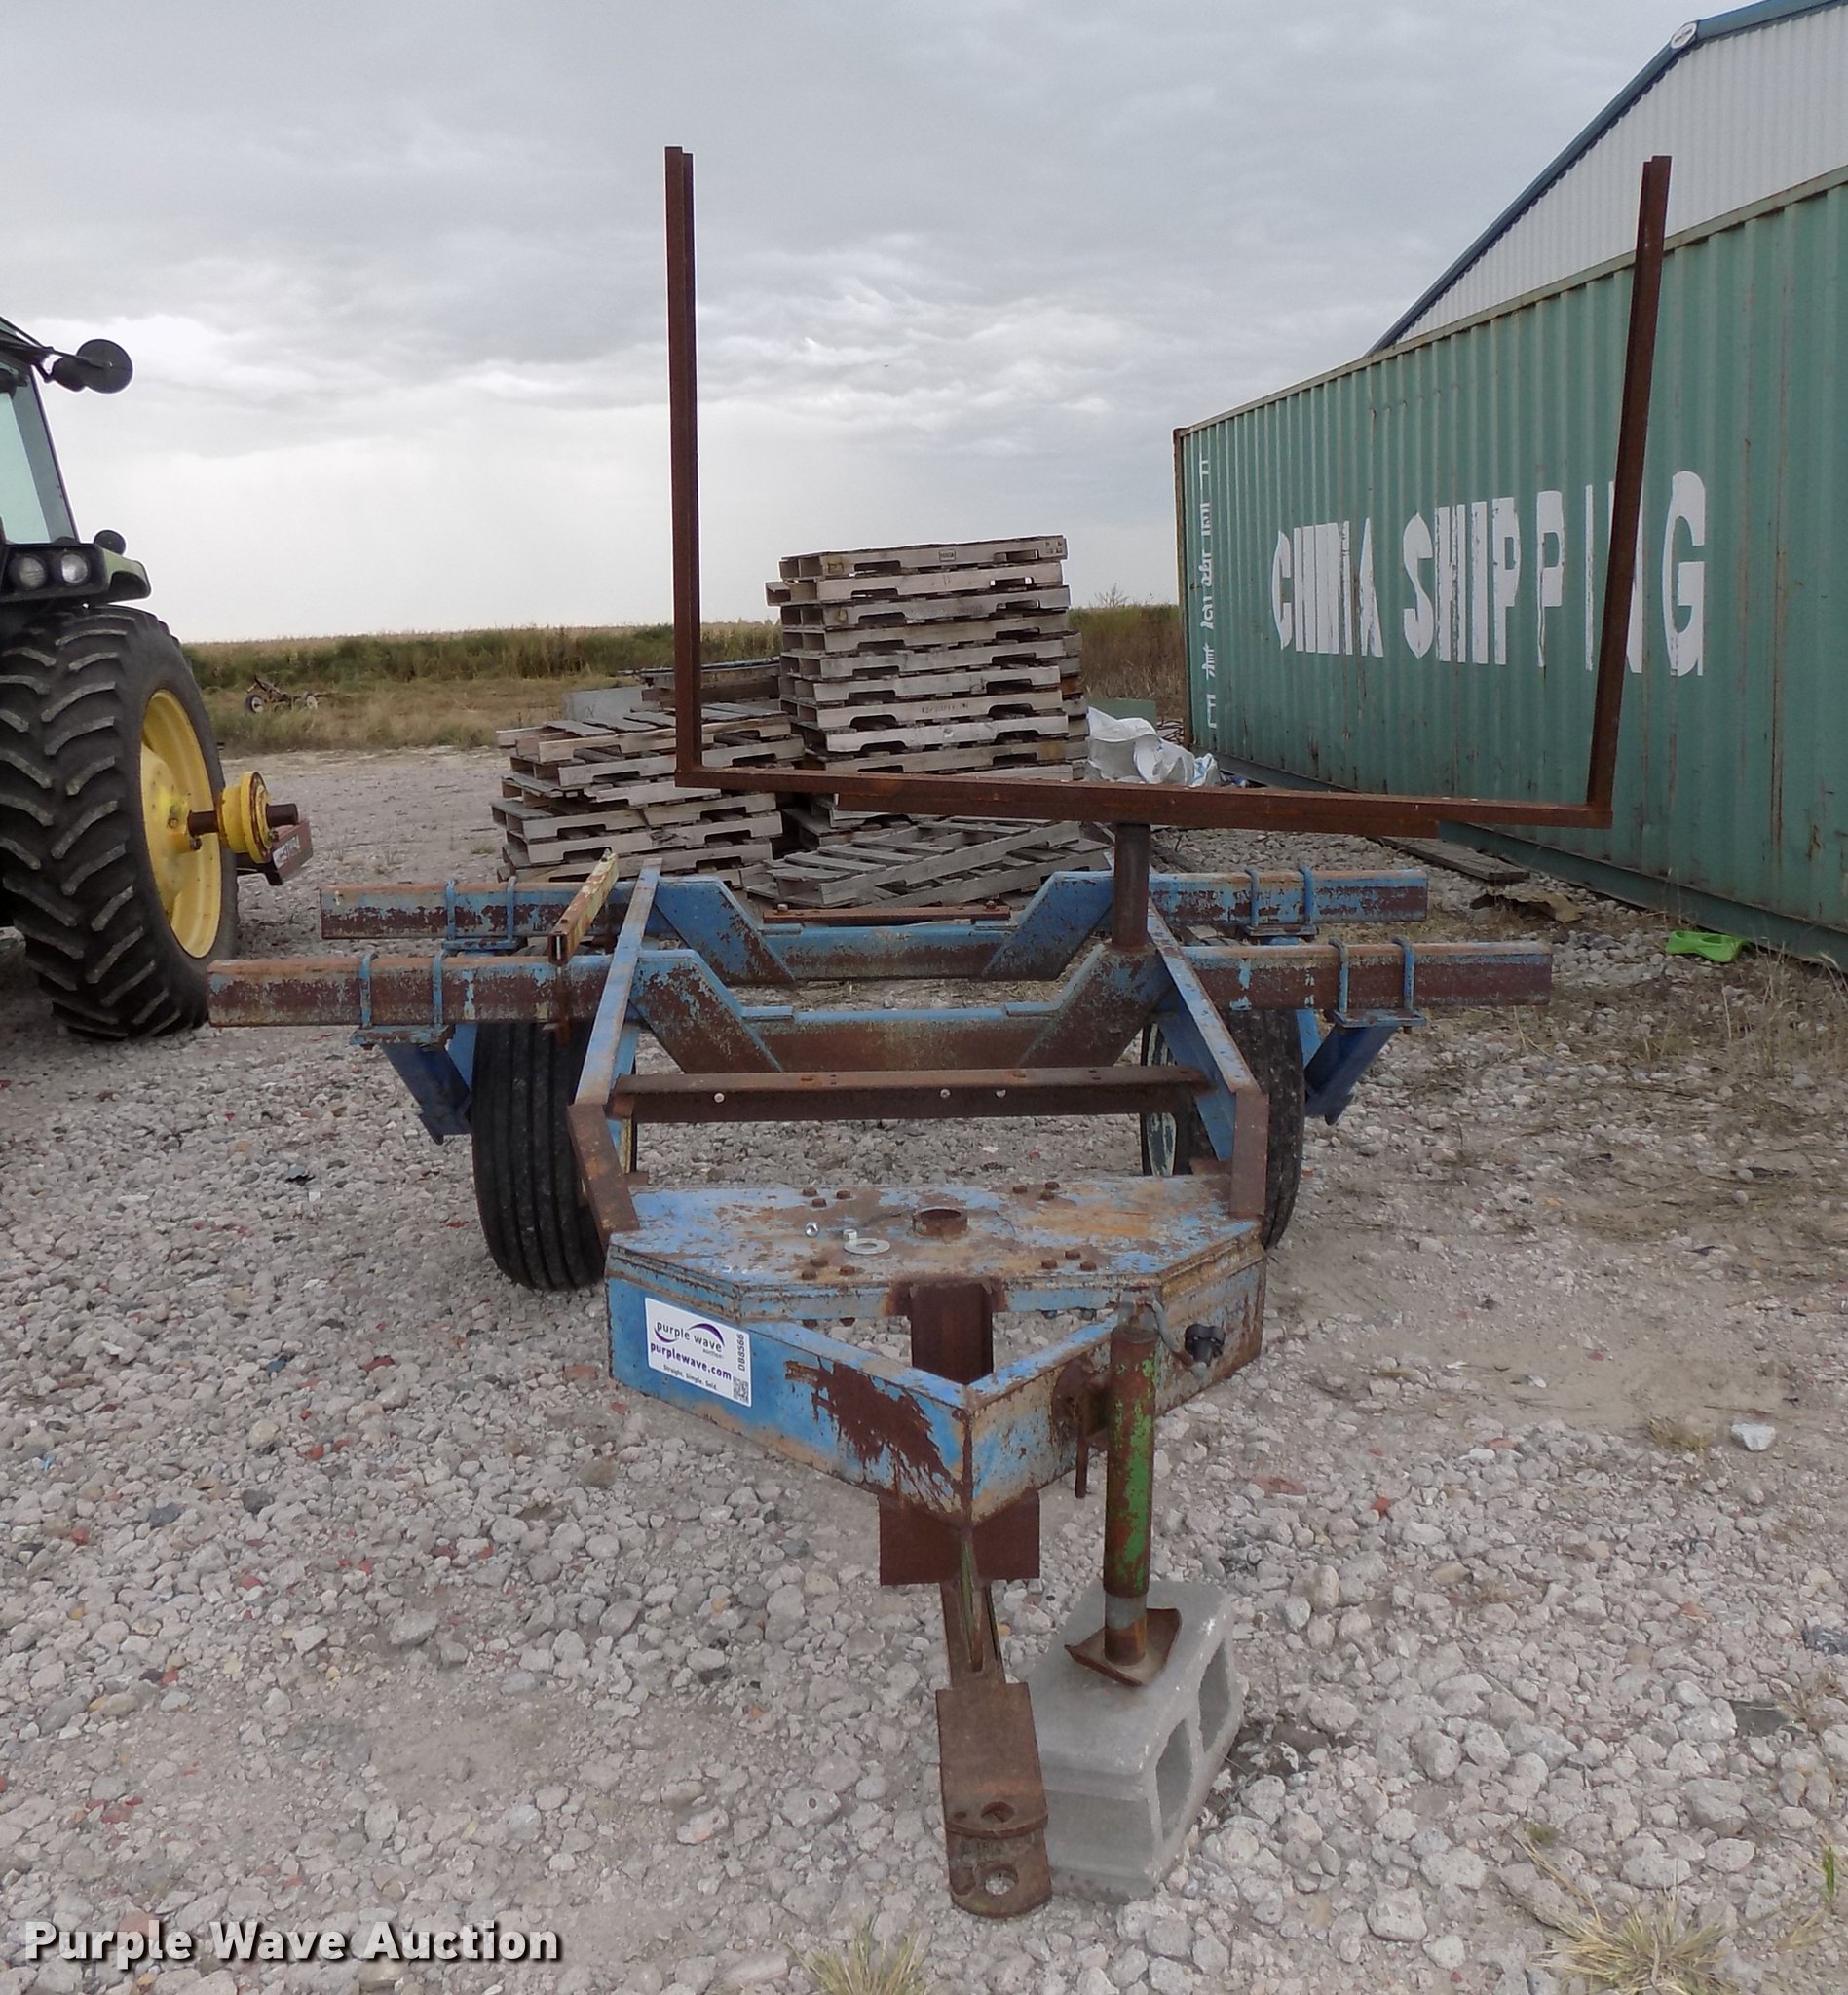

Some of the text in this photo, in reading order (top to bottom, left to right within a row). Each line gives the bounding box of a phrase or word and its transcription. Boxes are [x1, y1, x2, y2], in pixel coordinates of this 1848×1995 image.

[1272, 517, 1383, 658] CHINA
[657, 1322, 722, 1352] purple wave
[736, 1334, 745, 1372] DB8566
[650, 1342, 732, 1381] purplewave.com
